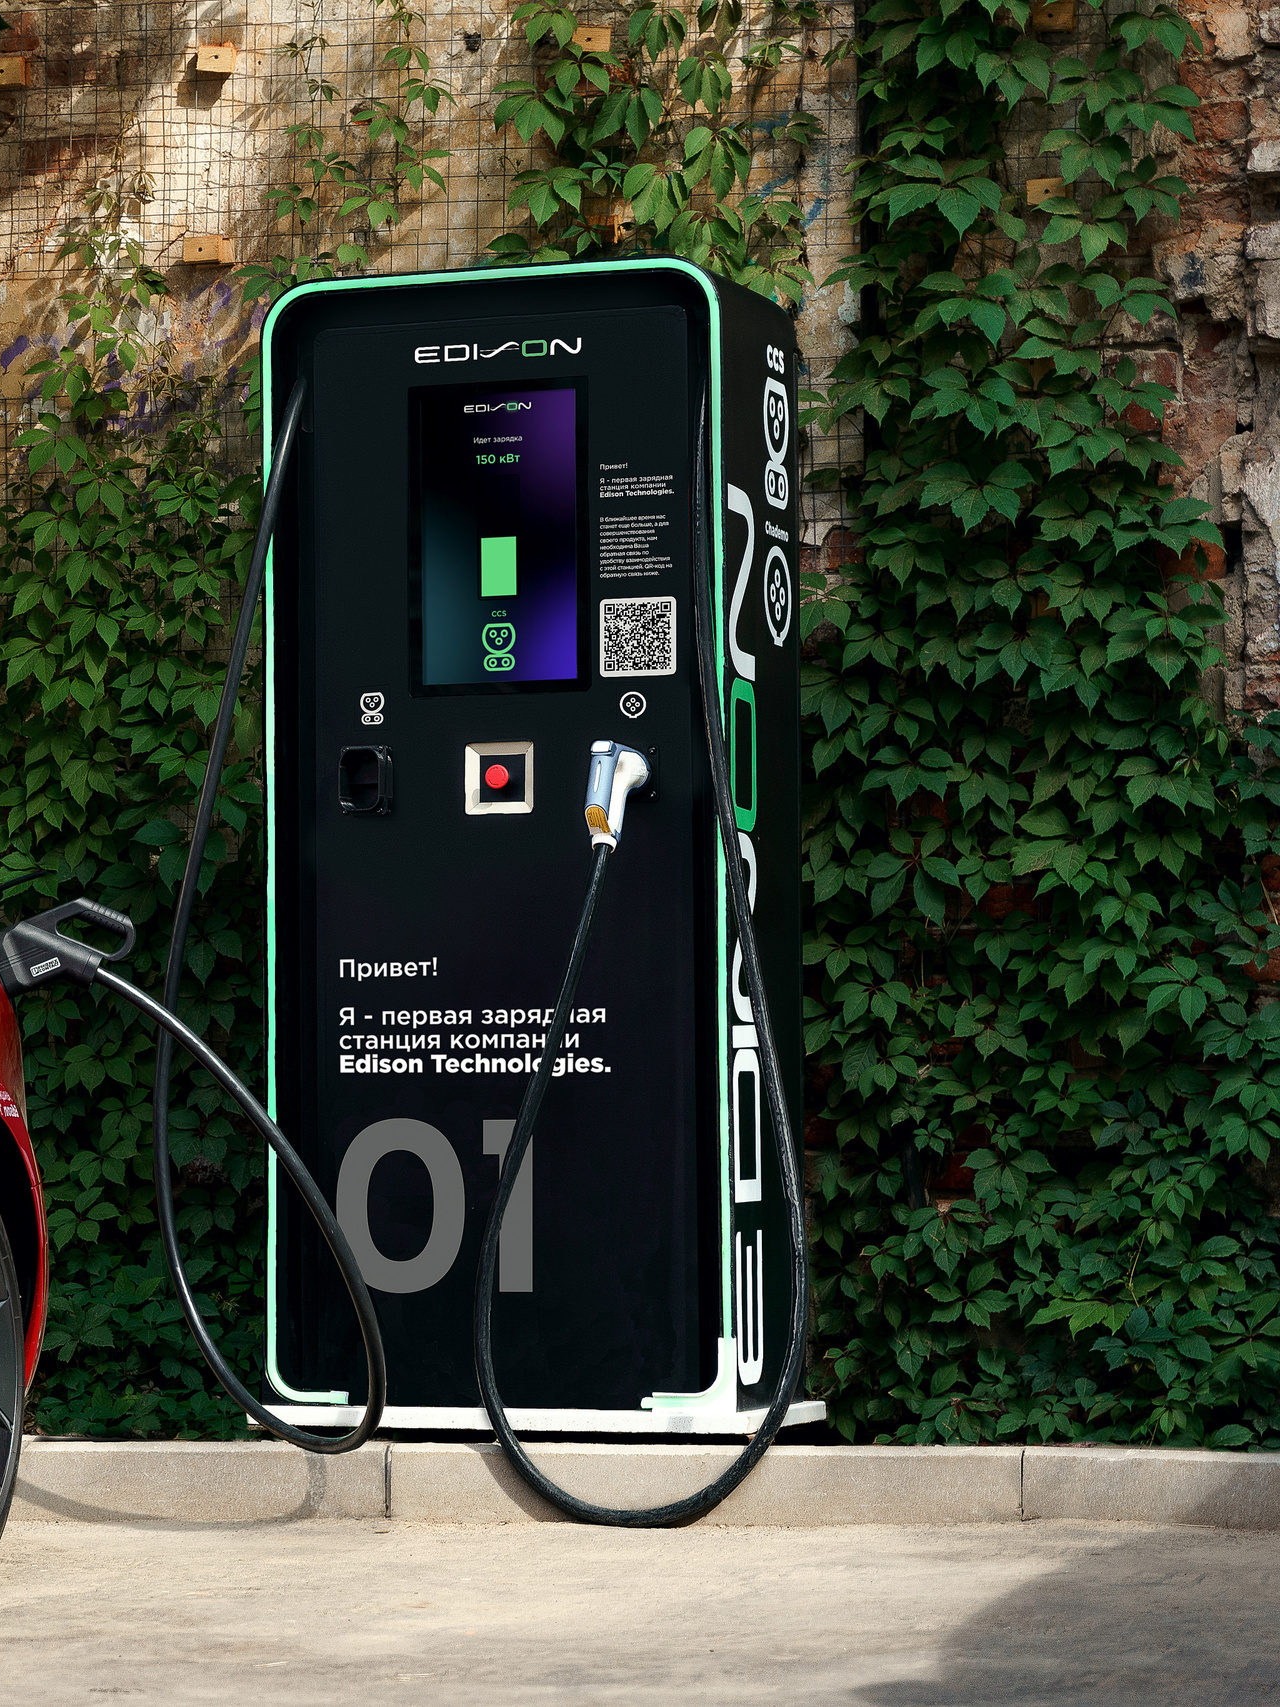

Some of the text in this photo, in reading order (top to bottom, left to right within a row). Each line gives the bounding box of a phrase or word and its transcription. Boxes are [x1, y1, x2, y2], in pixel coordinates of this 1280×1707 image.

[414, 338, 582, 364] EDISON
[766, 344, 784, 374] CCS
[473, 434, 522, 444] Идет зарядка
[476, 453, 520, 465] 150 кВт
[600, 462, 628, 471] Привет!
[625, 488, 674, 497] Technologies.
[765, 520, 789, 543] Chademo
[339, 957, 438, 981] Привет!
[339, 1008, 354, 1026] Я
[382, 1008, 472, 1028] первая
[339, 1032, 580, 1052] станция компани
[339, 1052, 612, 1077] Edison Technologies.
[336, 1118, 534, 1294] 01
